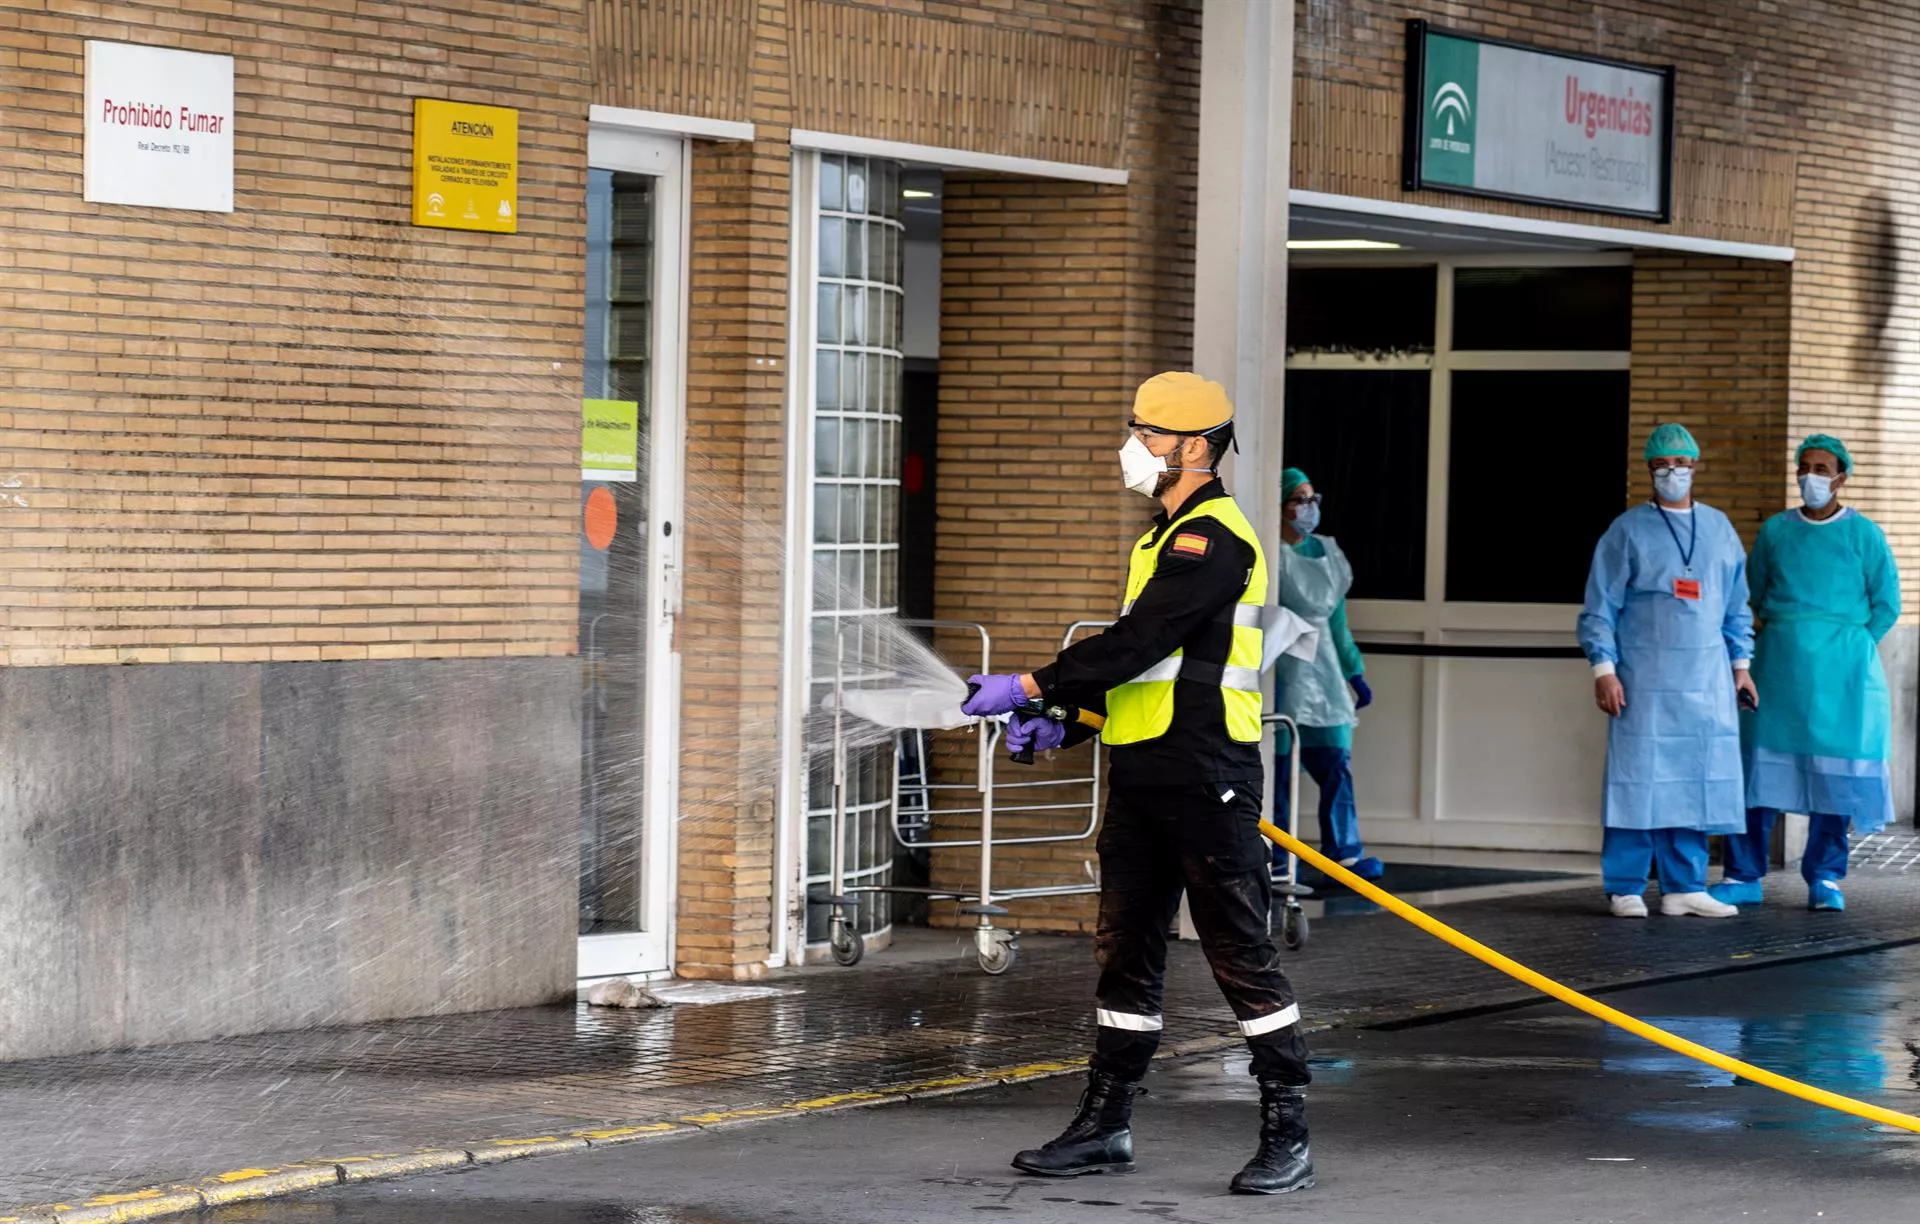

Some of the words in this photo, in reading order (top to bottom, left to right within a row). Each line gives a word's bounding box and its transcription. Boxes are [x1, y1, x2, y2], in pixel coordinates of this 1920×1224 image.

[103, 98, 172, 129] Prohibido
[179, 106, 224, 134] Fumar
[1565, 75, 1652, 139] Urgencias
[452, 121, 494, 137] ATENCIÓN
